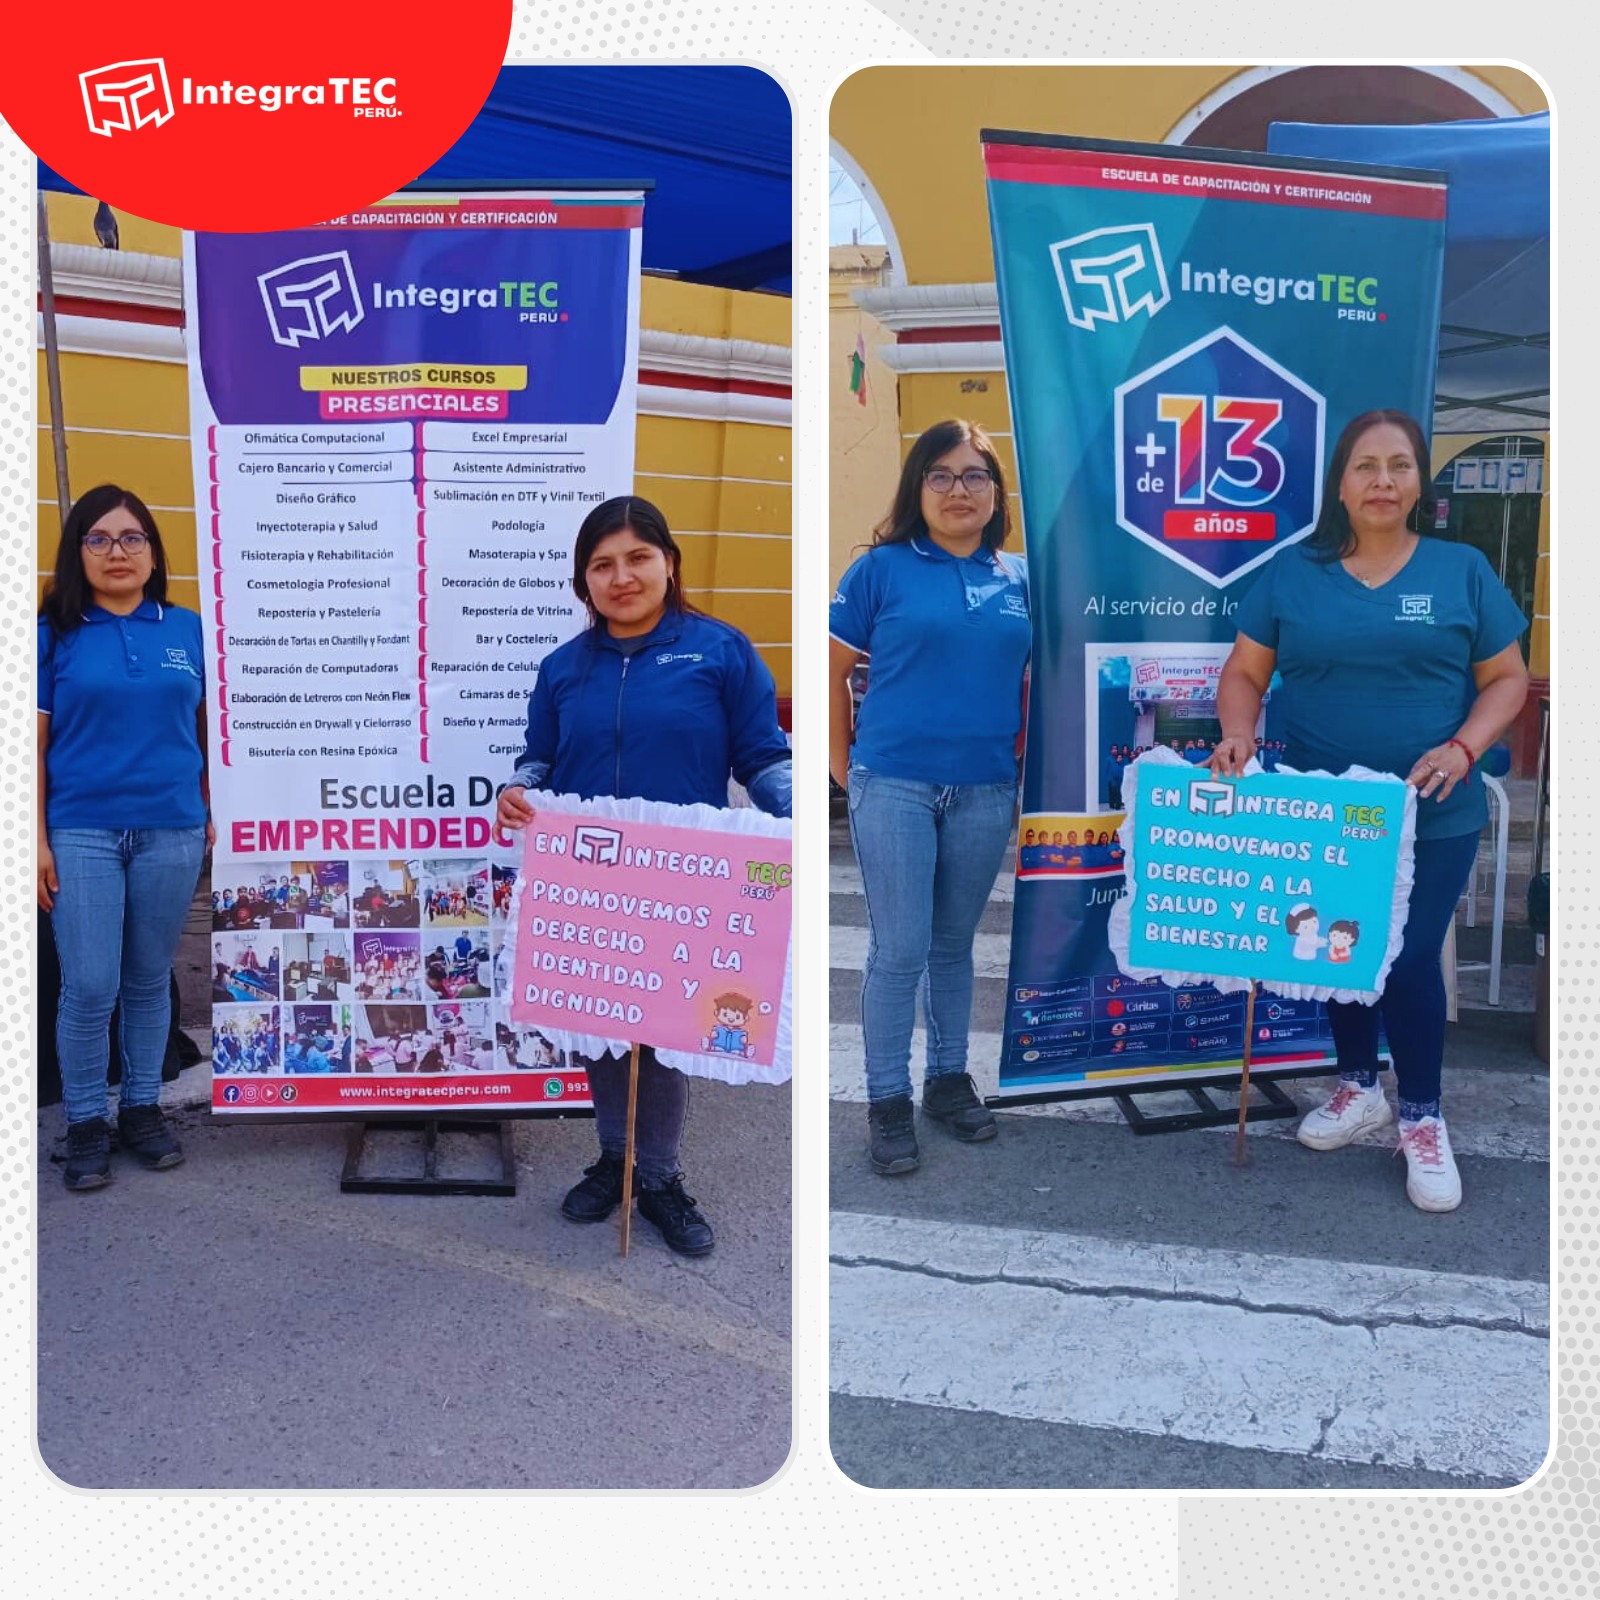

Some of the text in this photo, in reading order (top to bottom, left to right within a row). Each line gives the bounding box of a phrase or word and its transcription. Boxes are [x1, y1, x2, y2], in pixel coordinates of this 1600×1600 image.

[1102, 168, 1372, 204] ESCUELA DE CAPACITACIÓN Y CERTIFICACIÓN
[352, 211, 445, 225] CAPACITACIÓN
[449, 212, 457, 223] Y
[460, 211, 558, 224] CERTIFICACIÓN
[1181, 262, 1378, 306] IntegraTEC
[373, 282, 558, 315] IntegraTEC
[332, 368, 496, 385] NUESTROS CURSOS
[328, 393, 499, 413] PRESENCIALES
[244, 432, 385, 446] Ofimática Computacional
[472, 432, 567, 444] Excel Empresarial
[1157, 393, 1285, 507] 13
[239, 462, 393, 475] Cajero Bancario y Comercial
[453, 462, 586, 474] Asistente Administrativo
[1136, 472, 1164, 493] de
[276, 494, 356, 504] Diseño Gráfico
[434, 490, 605, 503] Sublimación en DTF y Vinil Textil
[256, 520, 378, 534] Inyectoterapia y Salud
[1194, 514, 1248, 534] años
[241, 549, 394, 563] Fisioterapia y Rehabilitación
[469, 549, 567, 561] Masoterapia y Spa
[328, 578, 390, 589] Profesional
[442, 577, 499, 587] Decoración
[502, 577, 516, 587] de
[519, 578, 555, 588] Globos
[558, 580, 564, 590] y
[521, 607, 534, 616] de
[537, 606, 573, 616] Vitrina
[1084, 596, 1105, 615] Al
[1111, 596, 1185, 616] servicio
[1191, 597, 1217, 616] de
[319, 609, 325, 619] y
[229, 636, 275, 646] Decoración
[278, 637, 289, 646] de
[291, 637, 316, 646] Tortas
[319, 638, 330, 646] en
[370, 637, 375, 647] y
[377, 635, 410, 644] Fondant
[476, 634, 494, 644] Bar
[497, 636, 503, 646] y
[242, 664, 399, 675] Reparación de Computadoras
[431, 662, 541, 673] Reparación de Celula
[232, 691, 411, 704] Elaboración de Letreros con Neón Flex
[460, 690, 504, 699] Cámaras
[507, 690, 520, 699] de
[232, 720, 297, 730] Construcción
[315, 720, 352, 730] Drywall
[355, 722, 361, 730] y
[363, 718, 412, 728] Cielorraso
[443, 717, 527, 728] Diseño y Armado
[298, 749, 318, 757] con
[320, 746, 355, 756] Resina
[358, 746, 398, 757] Epóxica
[320, 775, 455, 810] Escuela
[1151, 788, 1386, 827] EN INTEGRA TEC
[1149, 826, 1349, 867] PROMOVEMOS EL
[535, 833, 792, 887] EN INTEGRA TEC
[1147, 862, 1313, 896] DERECHO A LA
[532, 880, 757, 936] PROMOVEMOS EL
[1145, 893, 1280, 926] SALUD Y EL
[1145, 922, 1268, 952] BIENESTAR
[531, 917, 742, 972] DERECHO A LA
[531, 951, 699, 1000] IDENTIDAD Y
[525, 984, 643, 1024] DIGNIDAD
[340, 1083, 511, 1099] www.integratecperu.com
